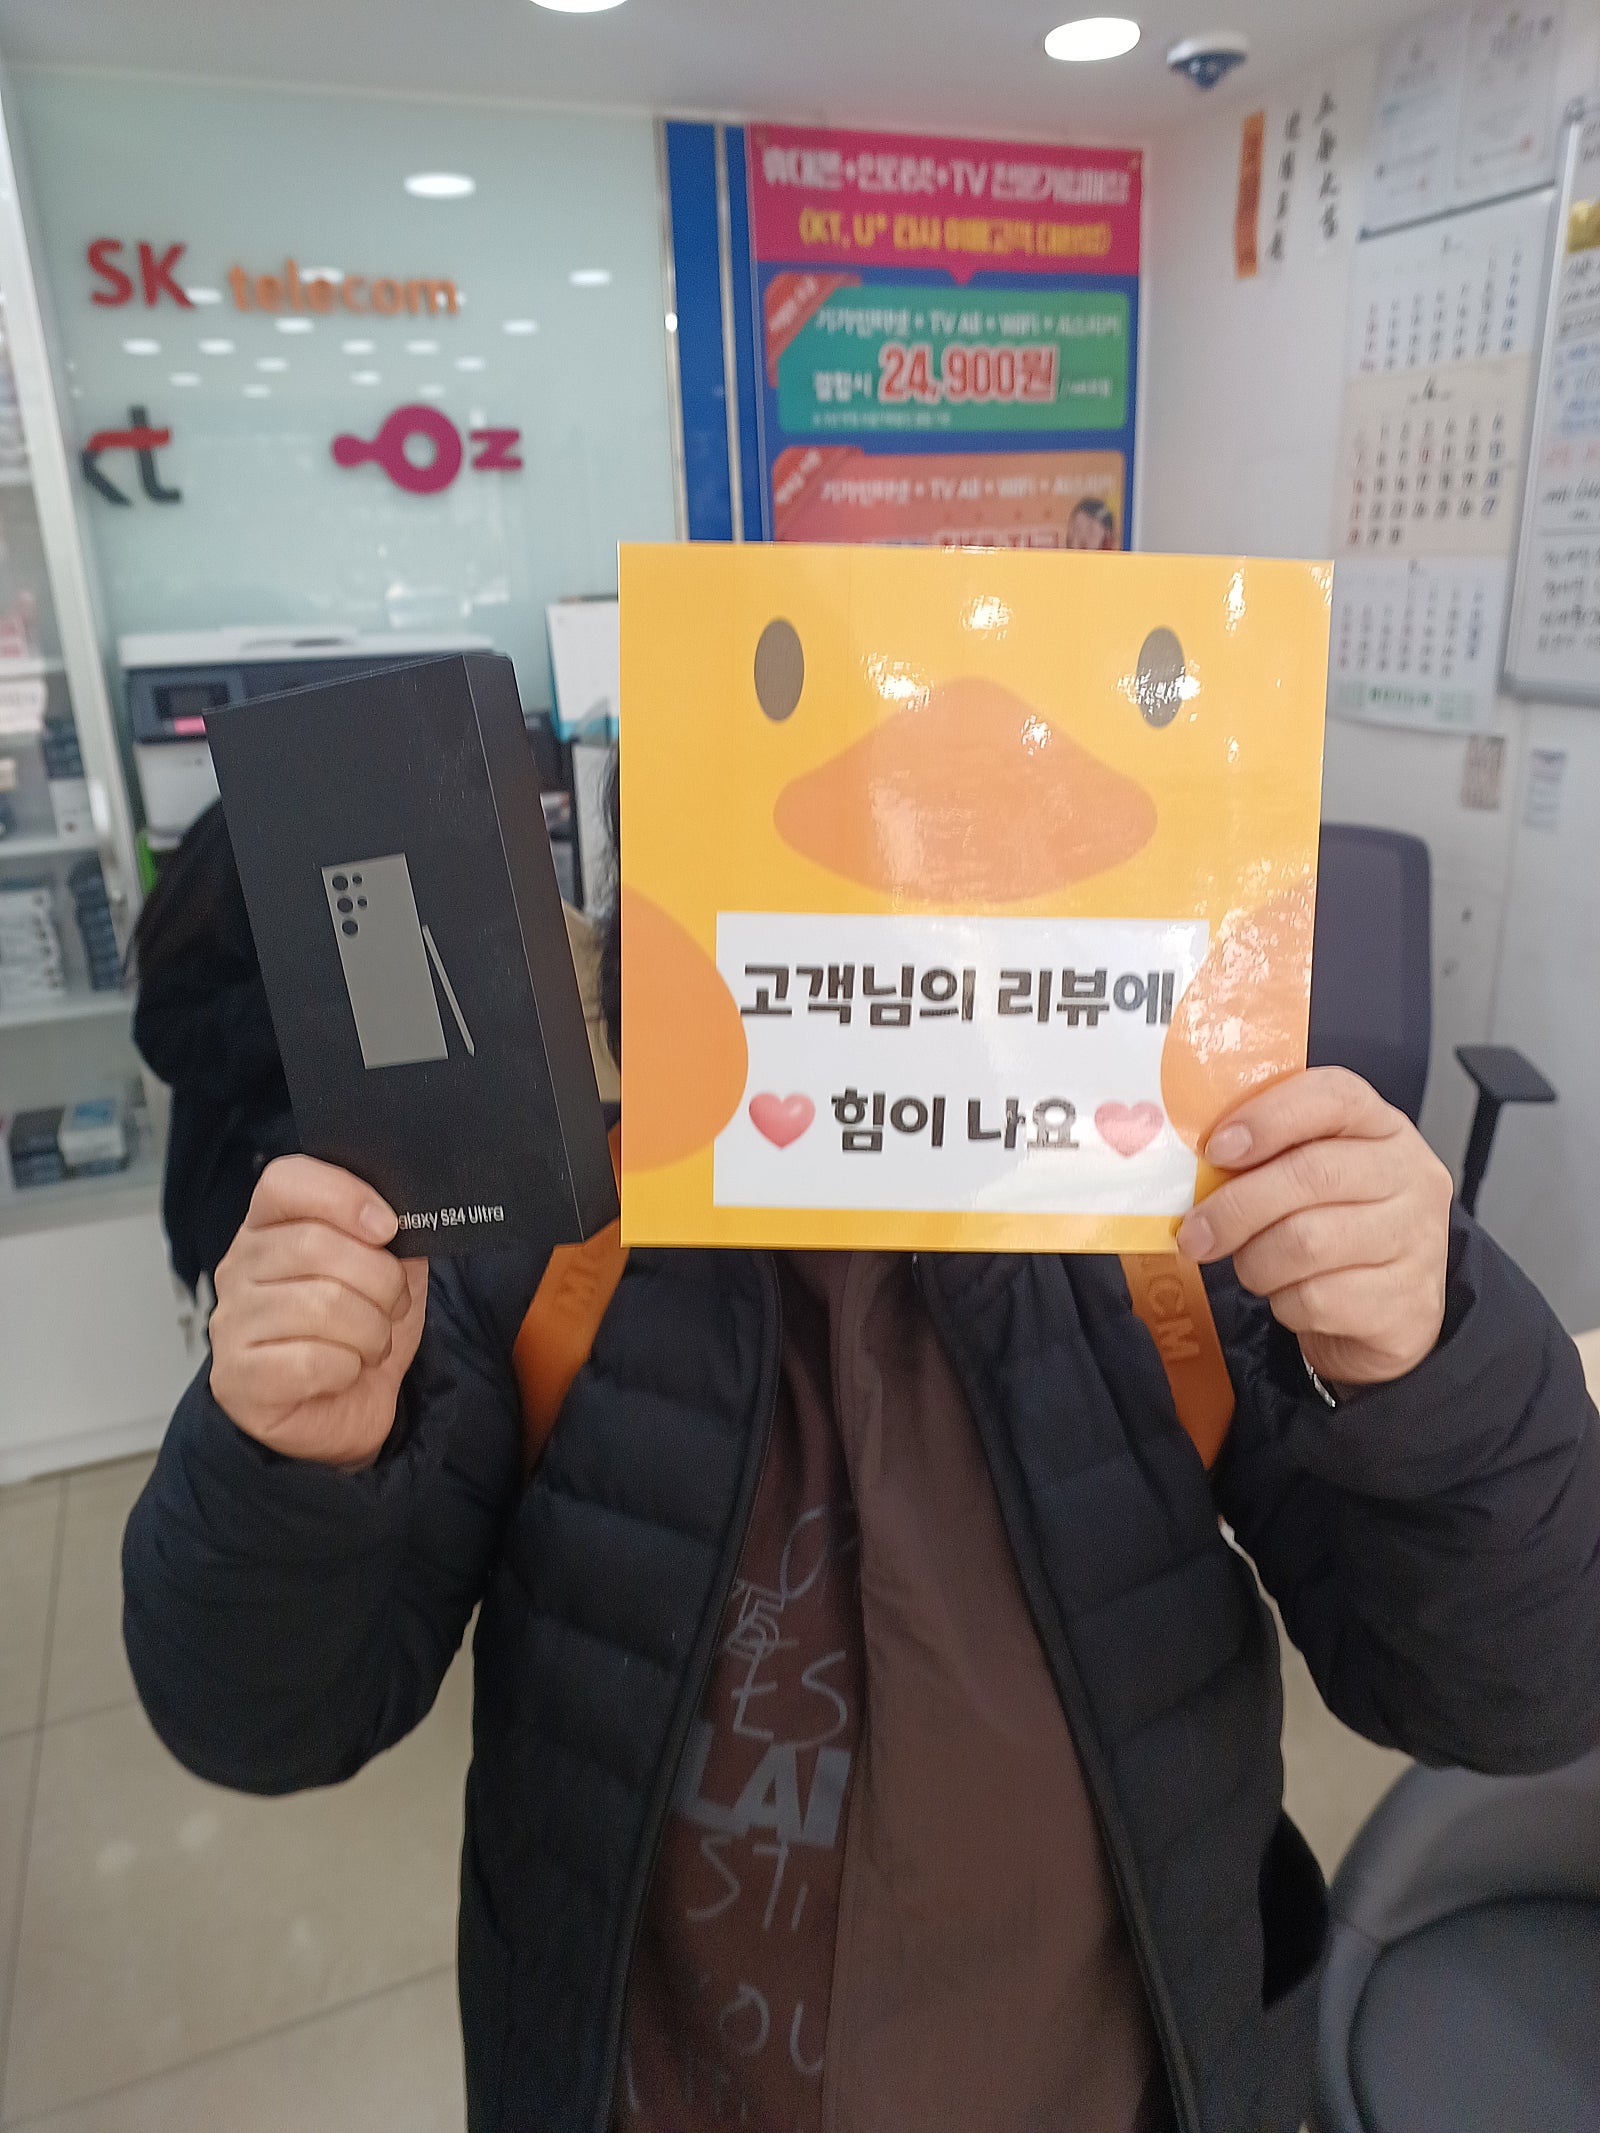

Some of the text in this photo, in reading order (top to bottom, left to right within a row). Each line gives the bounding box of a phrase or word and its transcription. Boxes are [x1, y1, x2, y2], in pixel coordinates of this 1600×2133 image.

[86, 238, 459, 316] SK telecom
[740, 963, 1176, 1027] 고객님의 리뷰에
[831, 1086, 1080, 1154] 힘이 나요
[398, 1204, 505, 1231] alaxy S24 Ultra
